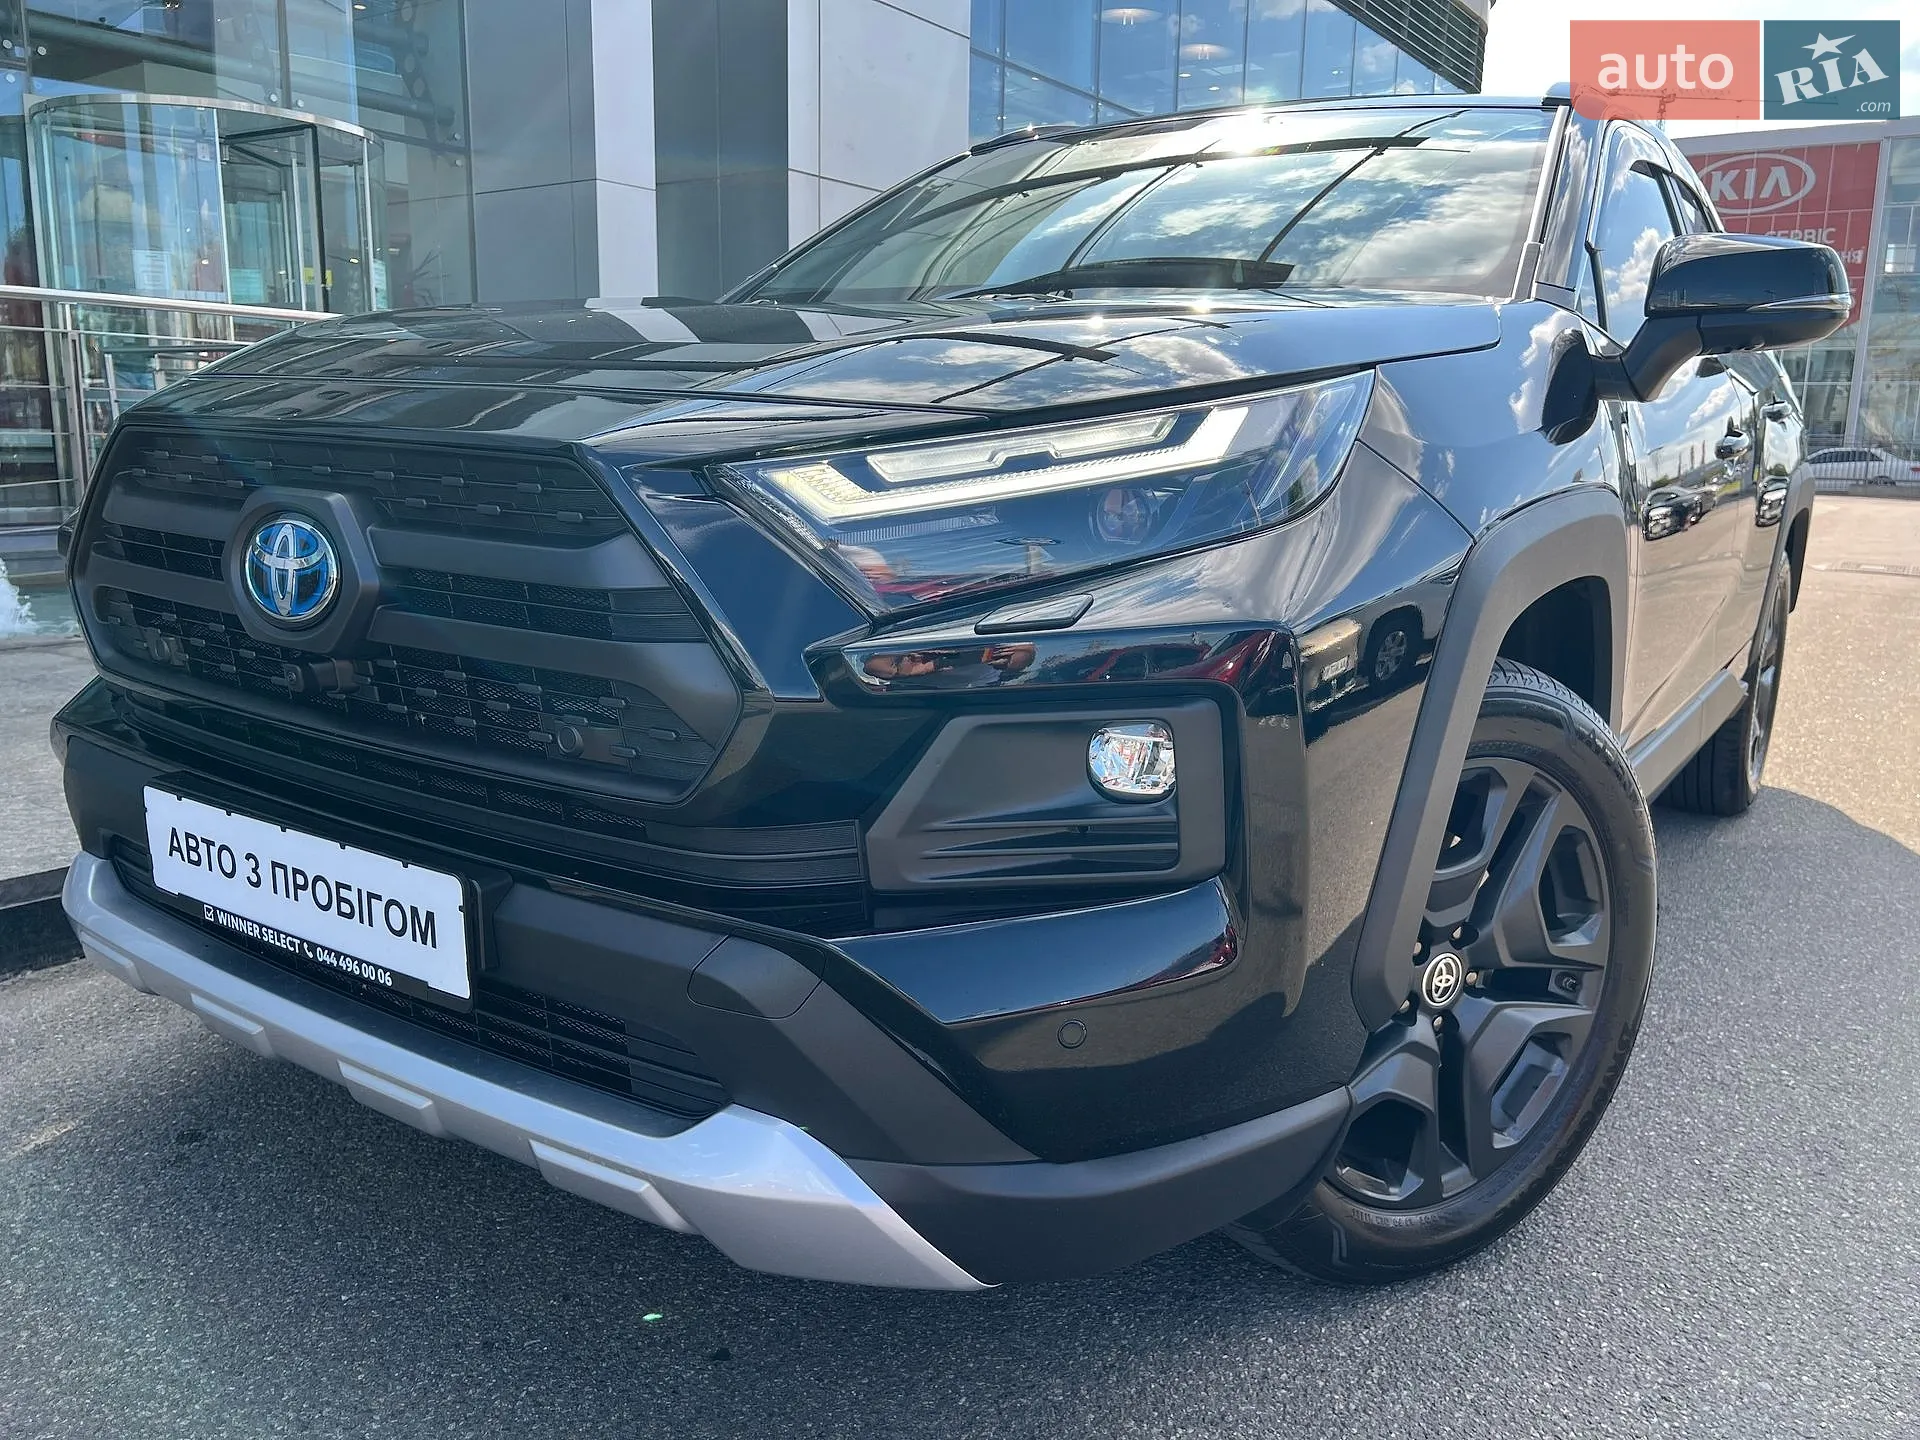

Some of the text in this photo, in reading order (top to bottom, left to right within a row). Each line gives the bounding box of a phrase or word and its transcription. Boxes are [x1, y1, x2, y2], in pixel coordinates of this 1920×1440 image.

[1710, 166, 1792, 201] KIA
[168, 827, 236, 879] АВТО
[270, 860, 437, 949] ПРОБІГОМ
[216, 909, 300, 954] WINNER SELECT
[316, 947, 393, 987] 044 496 00 06
